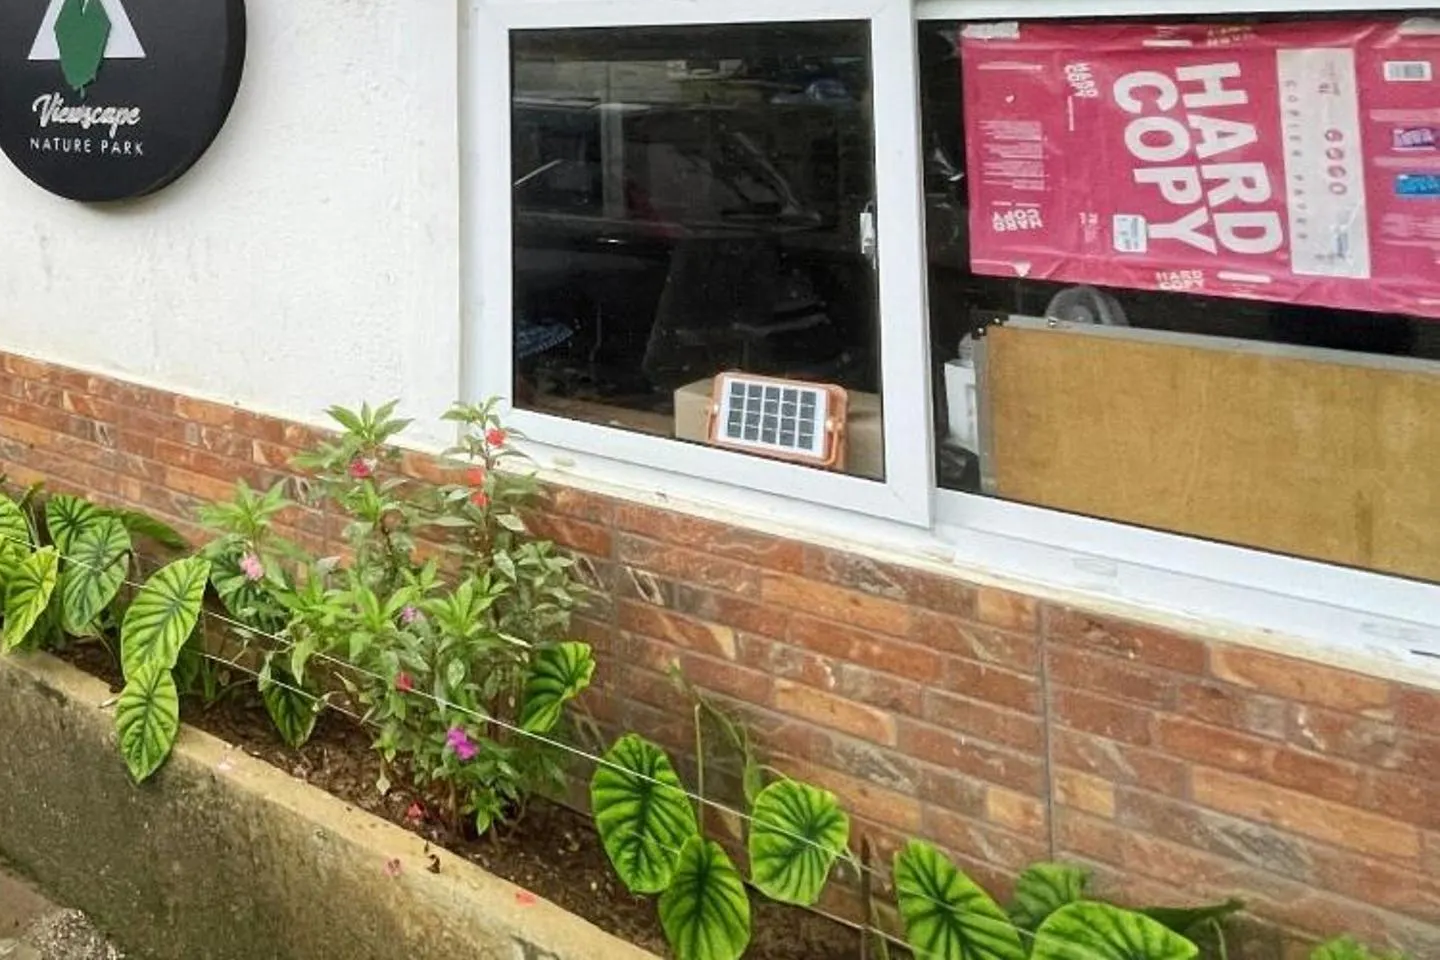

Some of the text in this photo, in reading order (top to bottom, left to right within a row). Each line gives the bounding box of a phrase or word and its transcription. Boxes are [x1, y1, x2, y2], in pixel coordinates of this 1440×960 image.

[29, 138, 144, 156] NATURE PARK
[32, 92, 141, 138] Viewscape
[1112, 70, 1218, 256] COPY
[1175, 61, 1284, 255] HARD
